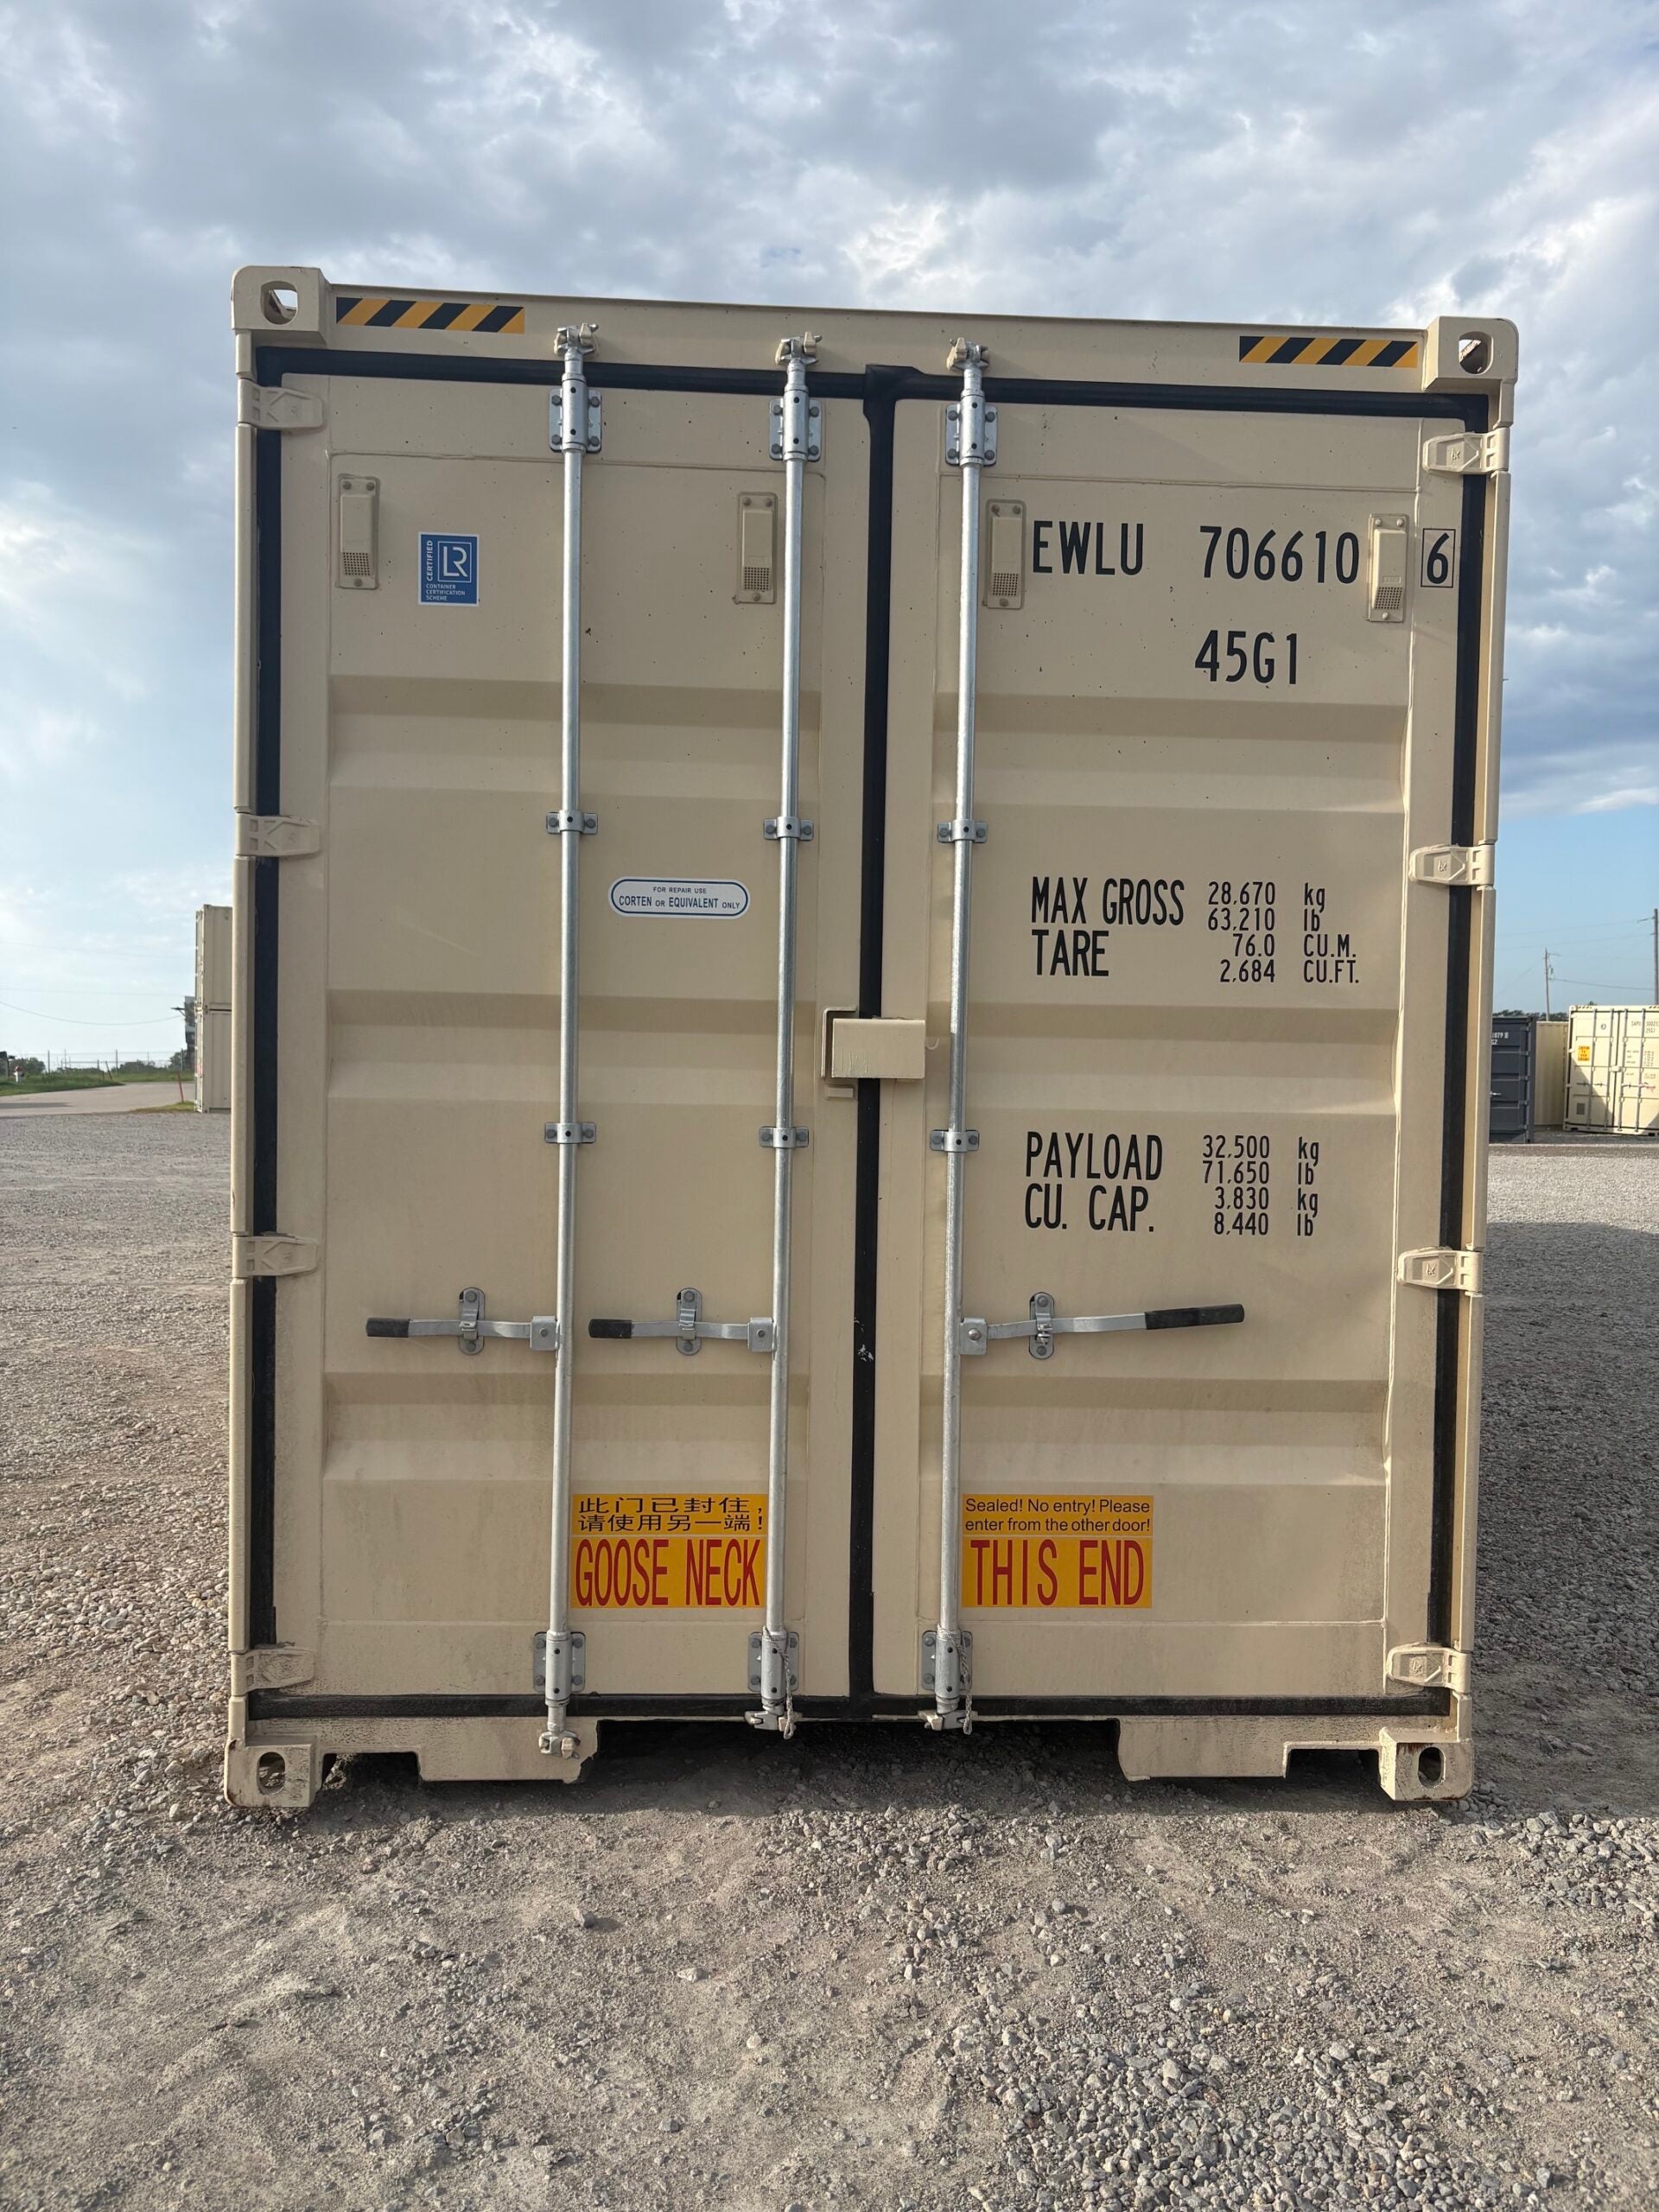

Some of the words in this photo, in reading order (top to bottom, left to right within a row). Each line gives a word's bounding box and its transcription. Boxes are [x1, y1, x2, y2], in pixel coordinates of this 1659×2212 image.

[443, 546, 468, 577] LR
[1033, 520, 1144, 575] EWLU
[1199, 525, 1360, 584] 706610
[1427, 532, 1451, 584] 6
[1194, 629, 1297, 684] 45G1
[619, 895, 652, 907] CORTEN
[669, 897, 719, 909] EQUIVALENT
[1031, 876, 1088, 925] MAX
[1102, 878, 1185, 926] GROSS
[1304, 882, 1325, 913] kg
[1303, 908, 1320, 932] lb
[1031, 929, 1109, 977] TARE
[1232, 933, 1275, 957] 76.0
[1303, 933, 1357, 958] CU.M.
[1303, 959, 1359, 983] CU.FT.
[1026, 1131, 1163, 1181] PAYLOAD
[1298, 1136, 1319, 1166] kg
[1298, 1162, 1314, 1185] lb
[1025, 1182, 1067, 1230] CU.
[1089, 1185, 1154, 1232] CAP.
[1297, 1188, 1319, 1218] kg
[1297, 1213, 1314, 1236] lb
[965, 1497, 1022, 1513] Sealed!
[1027, 1498, 1049, 1513] No
[1053, 1499, 1096, 1516] entry!
[1100, 1499, 1150, 1513] Please
[965, 1518, 1004, 1531] enter
[1007, 1517, 1041, 1532] from
[1046, 1518, 1068, 1532] the
[1071, 1518, 1110, 1532] other
[1112, 1518, 1150, 1532] door!
[575, 1538, 669, 1606] GOOSE
[685, 1538, 761, 1606] NECK
[970, 1539, 1058, 1606] THIS
[1078, 1539, 1144, 1605] END
